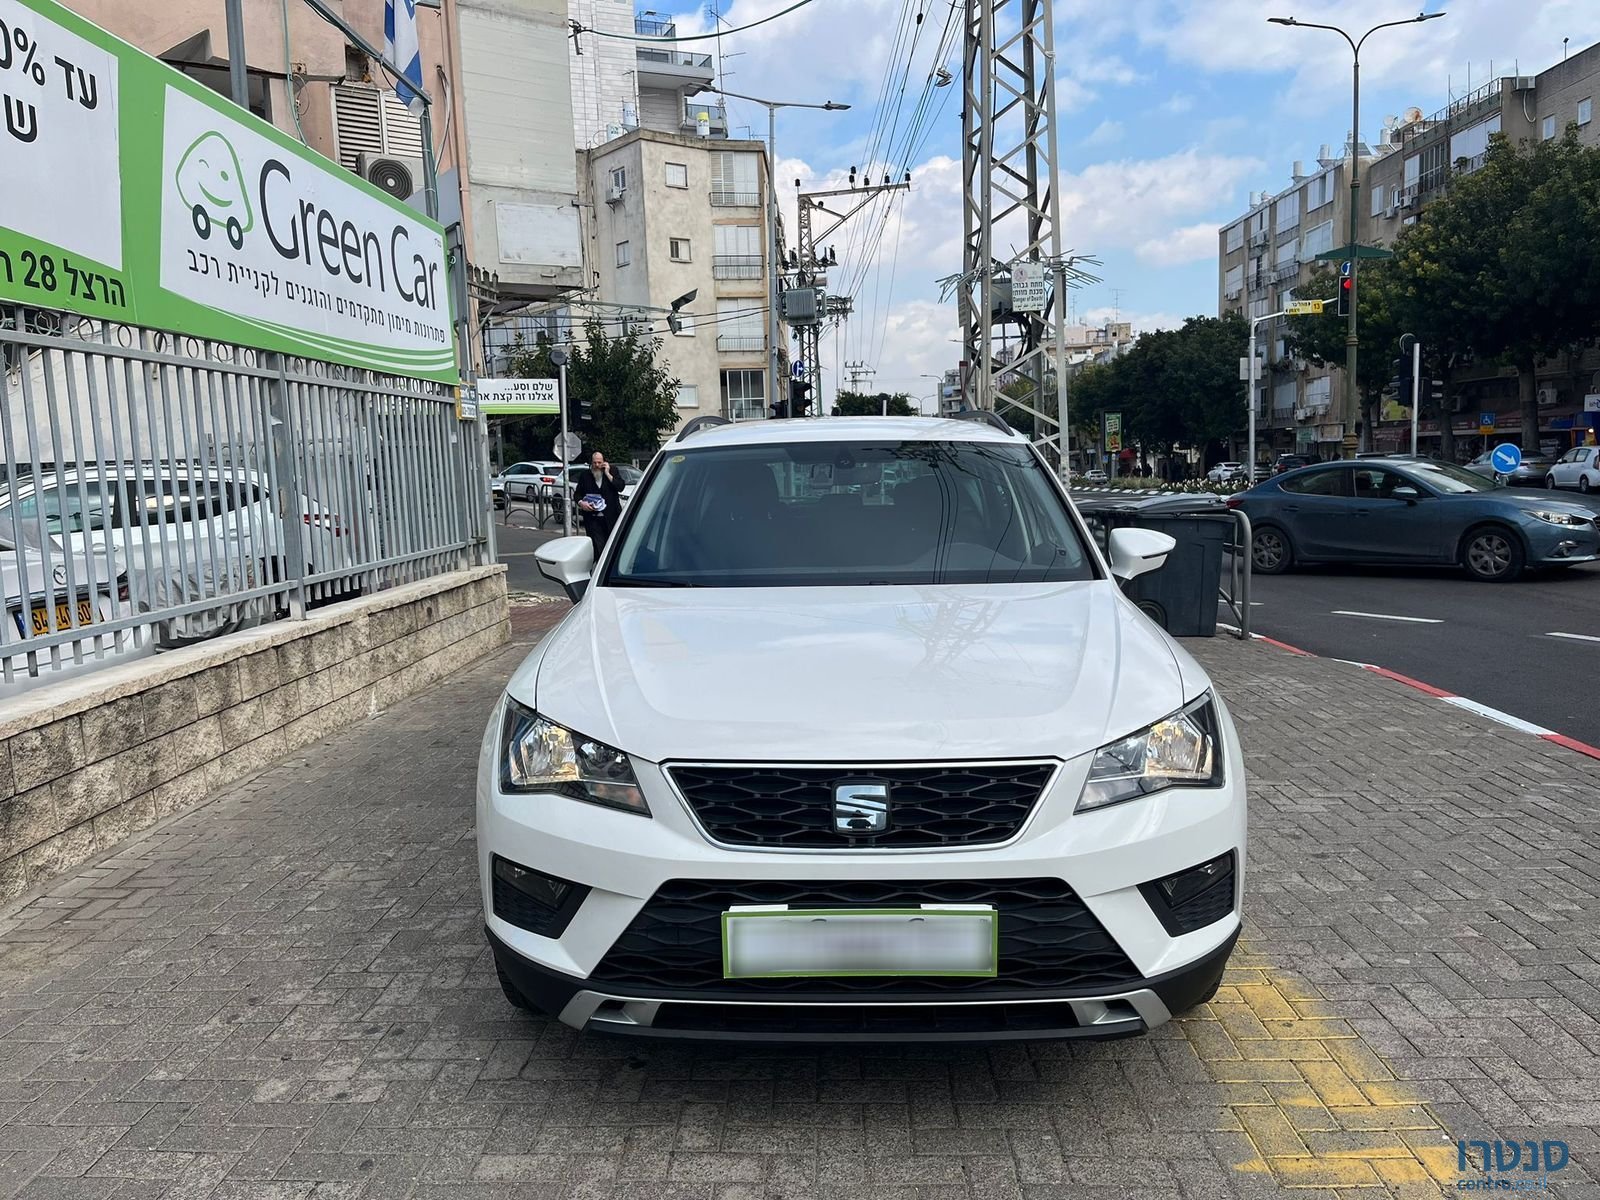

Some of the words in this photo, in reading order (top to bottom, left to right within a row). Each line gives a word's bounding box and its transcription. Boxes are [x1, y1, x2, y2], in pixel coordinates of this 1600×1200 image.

[53, 55, 98, 110] עד
[259, 158, 386, 293] Green
[390, 224, 438, 311] Car
[20, 250, 57, 292] 28
[187, 248, 221, 279] רכב
[62, 258, 126, 308] הרצל
[227, 261, 279, 298] לקניית
[286, 280, 332, 312] והוגנים
[336, 296, 385, 326] מתקדמים
[1313, 302, 1321, 310] 13
[387, 312, 411, 334] מימון
[414, 321, 445, 343] פתרונות
[493, 393, 512, 403] קצת
[515, 393, 526, 401] זה
[529, 392, 554, 401] אצלנו
[532, 382, 553, 391] שלם
